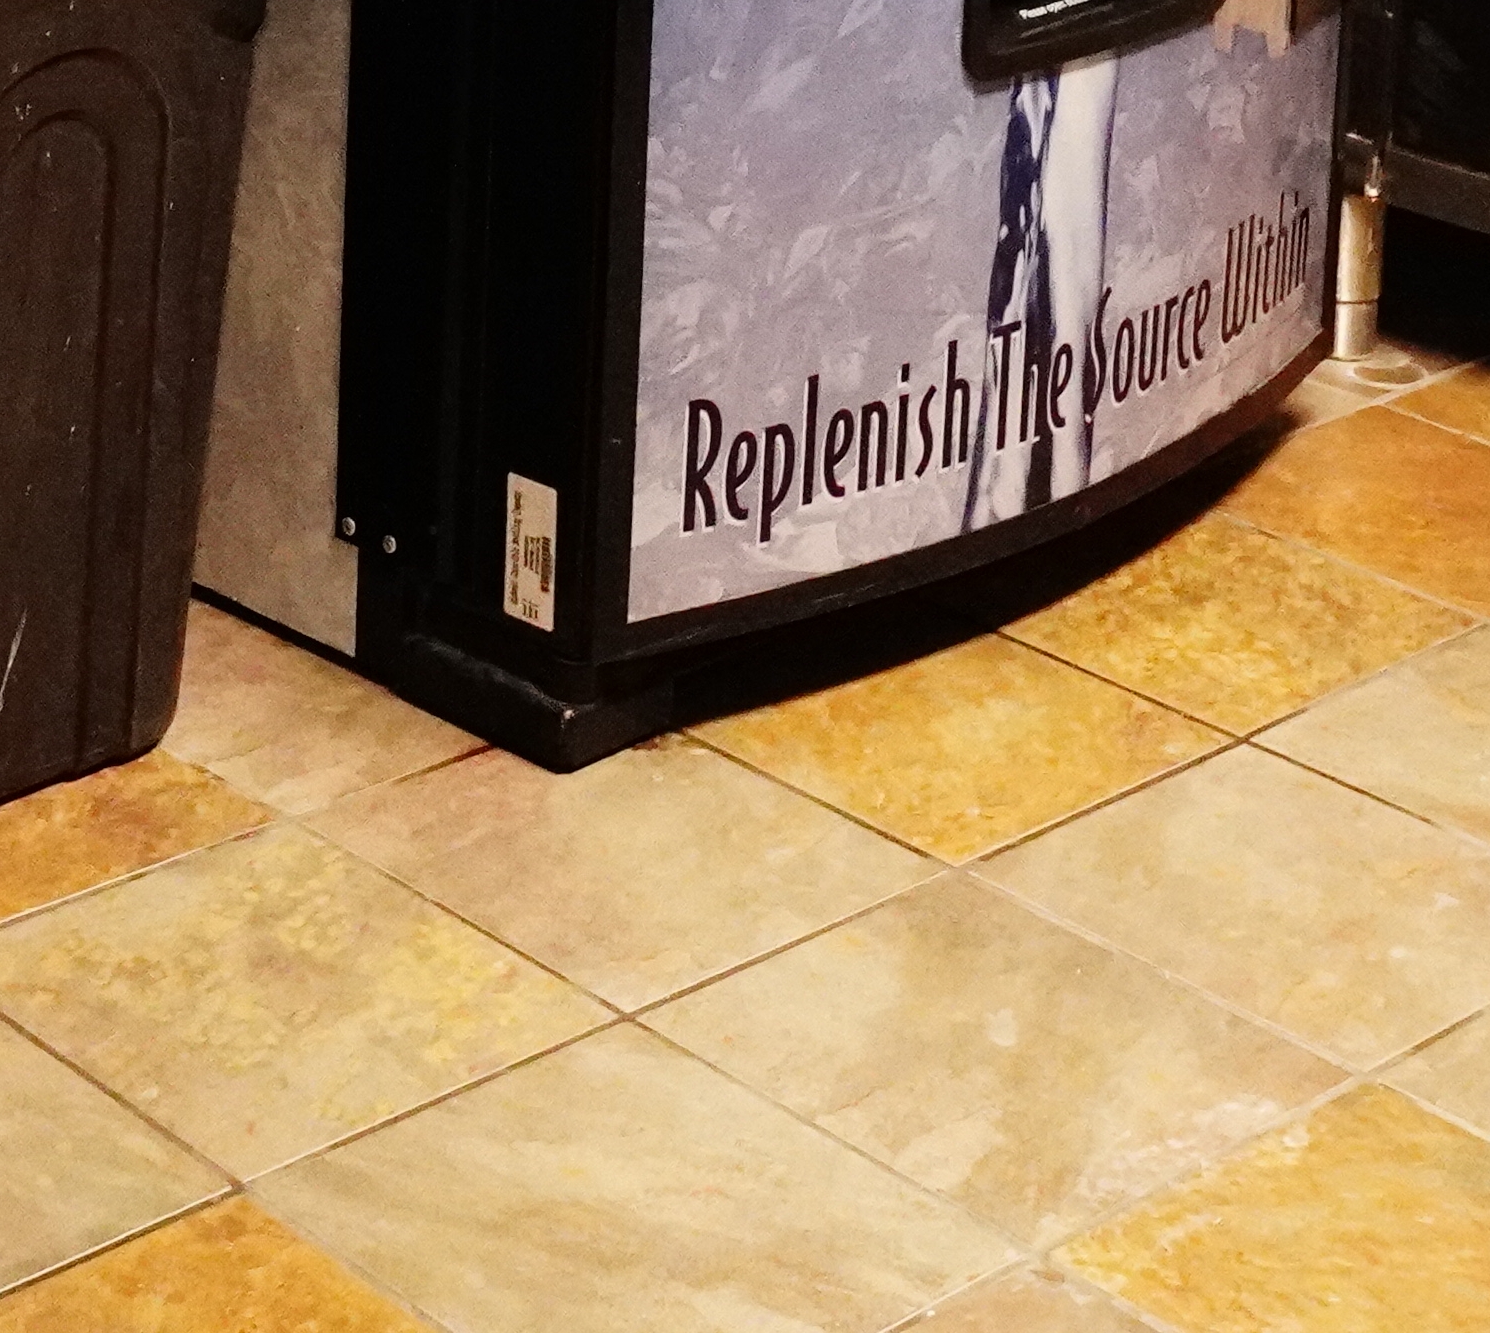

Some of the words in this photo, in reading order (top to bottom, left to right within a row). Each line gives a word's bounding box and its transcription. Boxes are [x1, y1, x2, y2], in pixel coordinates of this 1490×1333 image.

[679, 339, 970, 549] Replenish
[990, 320, 1075, 453] The
[1084, 278, 1212, 425] Source
[1219, 193, 1313, 347] Within
